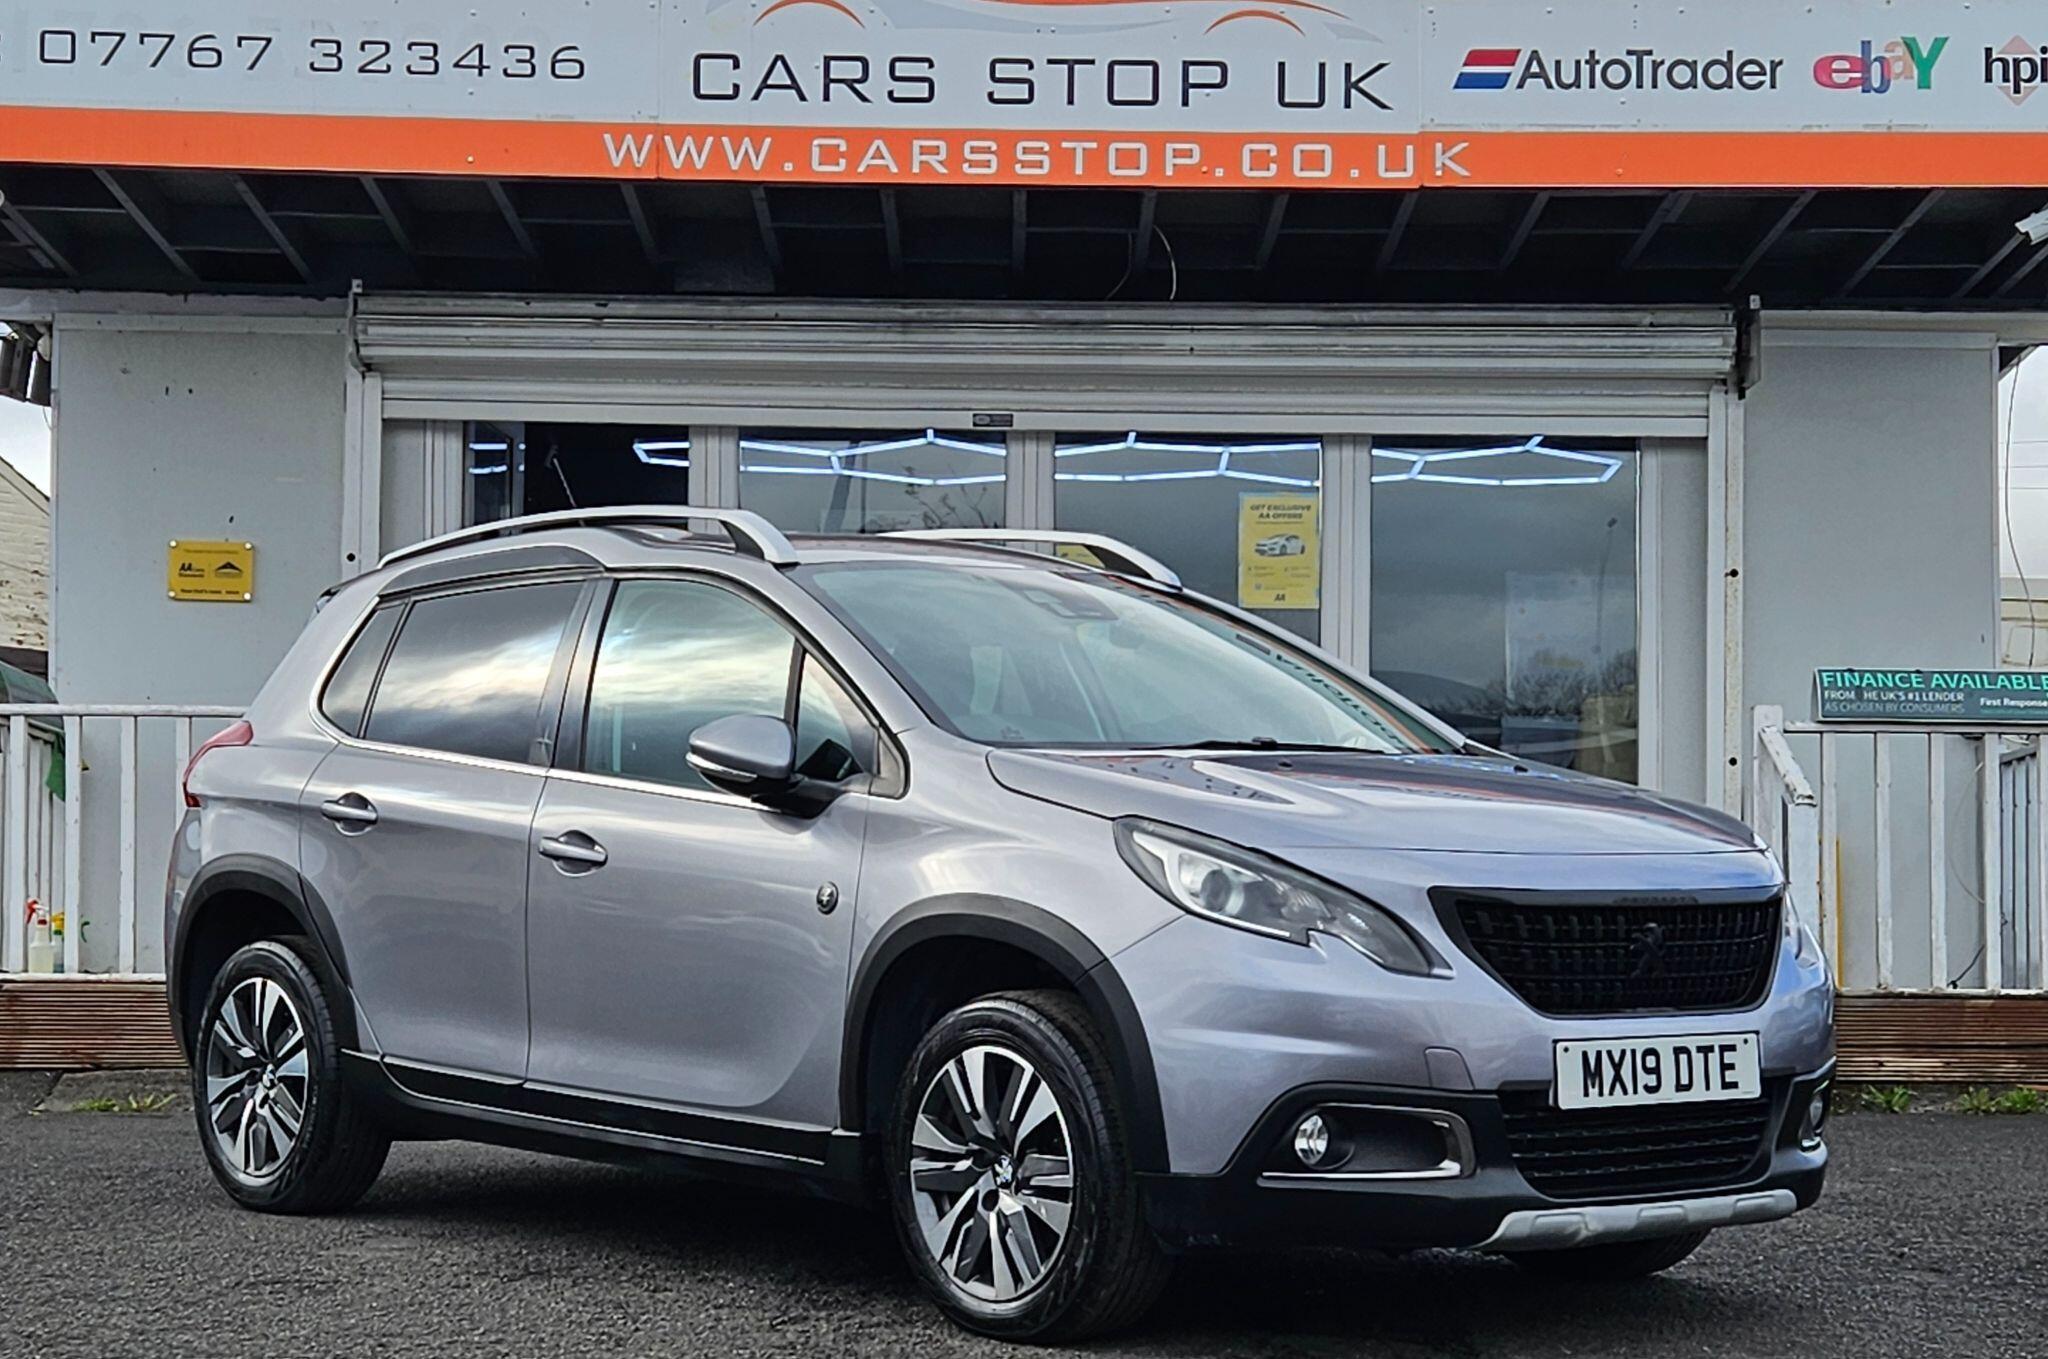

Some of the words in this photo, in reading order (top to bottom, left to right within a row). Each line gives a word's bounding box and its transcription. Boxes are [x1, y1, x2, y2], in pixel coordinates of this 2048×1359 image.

[39, 29, 273, 71] 07767
[309, 38, 585, 80] 323436
[1516, 48, 1785, 91] AutoTrader
[1984, 45, 2048, 95] hpi
[692, 52, 936, 104] CARS
[987, 57, 1229, 108] STOP
[1277, 61, 1394, 111] UK
[603, 133, 1472, 178] WWW.CARSSTOP.CO.UK
[1821, 671, 1925, 688] FINANCE
[1823, 690, 1855, 700] FROM
[1922, 692, 1965, 702] LENDER
[1824, 702, 1839, 712] AS
[1840, 702, 1887, 713] CHOSEN
[1887, 703, 1900, 713] BY
[1900, 703, 1965, 714] CONSUMERS
[1980, 698, 2001, 706] First
[1581, 1047, 1663, 1098] MX19
[1672, 1043, 1740, 1093] DTE
